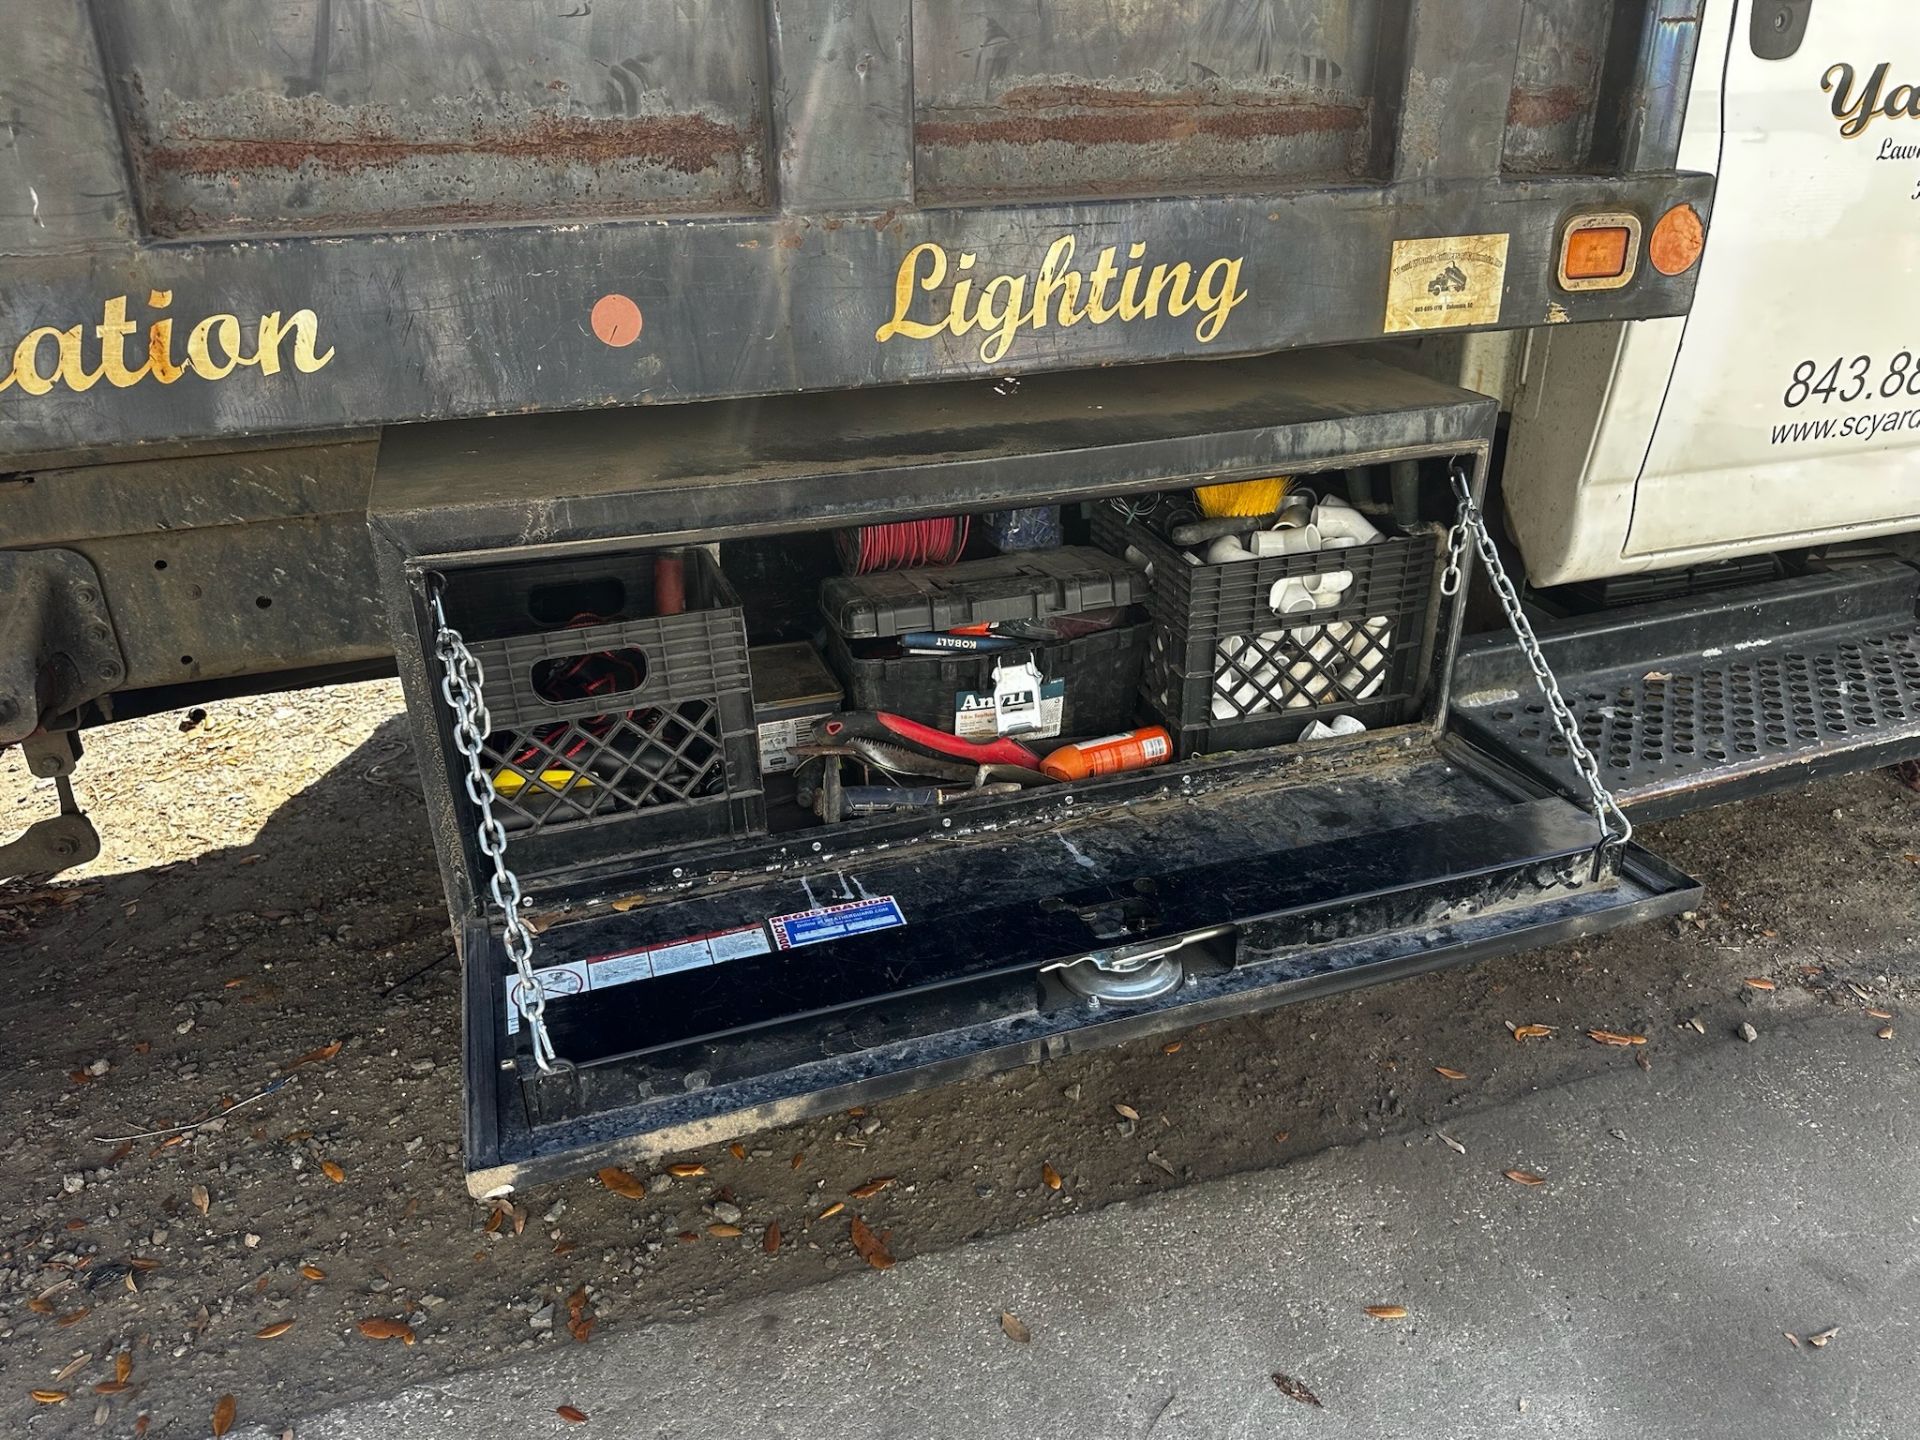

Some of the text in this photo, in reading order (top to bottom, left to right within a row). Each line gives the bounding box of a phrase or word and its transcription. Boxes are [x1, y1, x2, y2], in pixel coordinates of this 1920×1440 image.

[875, 233, 1248, 364] Lighting
[0, 289, 335, 395] ation
[936, 637, 977, 649] KOBALT
[771, 896, 892, 924] REGISTRATION
